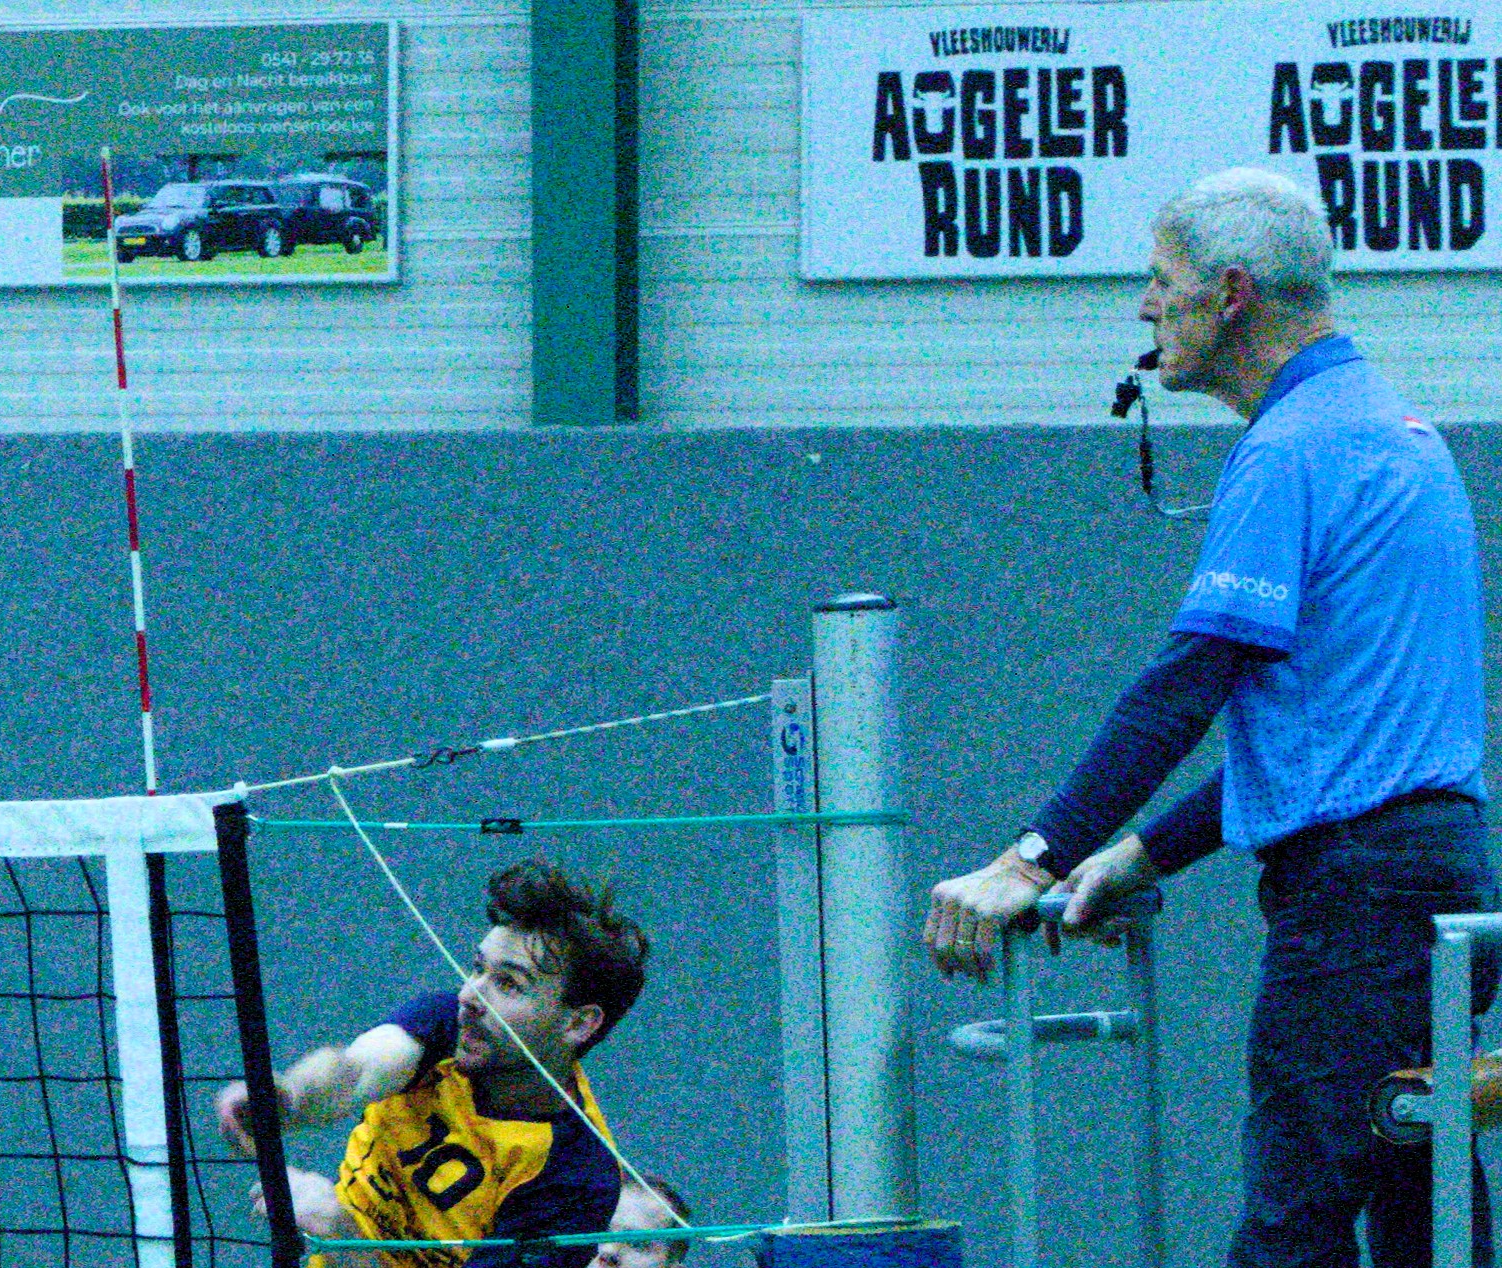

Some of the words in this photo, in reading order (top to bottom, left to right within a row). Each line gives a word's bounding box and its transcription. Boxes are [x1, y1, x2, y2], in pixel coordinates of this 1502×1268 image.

[929, 26, 1071, 58] VLEESHOUWERIJ
[1326, 15, 1472, 48] VLEESHOUWERIJ
[175, 75, 208, 92] Dag
[212, 77, 233, 89] en
[237, 74, 285, 89] Nacht
[118, 101, 150, 116] Ook
[155, 103, 187, 115] voor
[918, 160, 1085, 258] RUND
[1315, 153, 1487, 252] RUND
[1202, 570, 1289, 602] nevobo
[396, 1113, 486, 1210] 10
